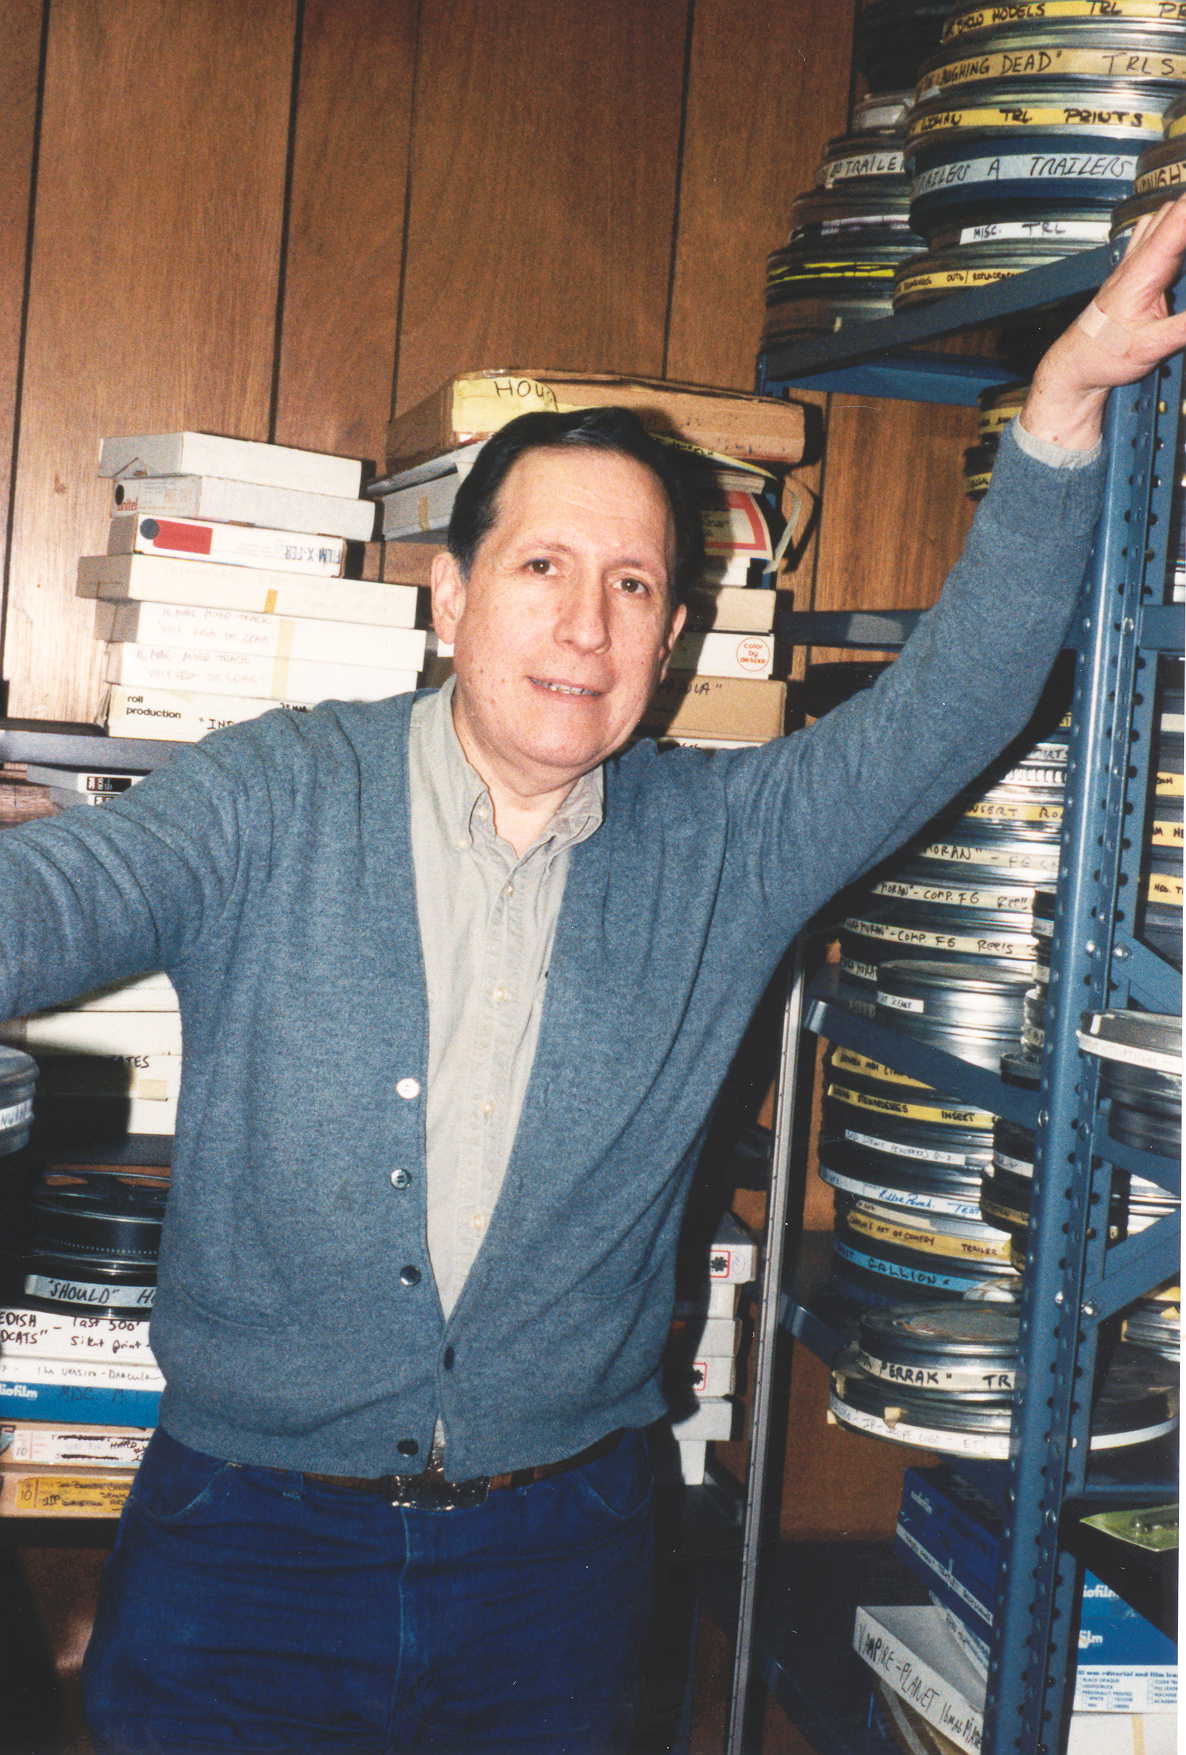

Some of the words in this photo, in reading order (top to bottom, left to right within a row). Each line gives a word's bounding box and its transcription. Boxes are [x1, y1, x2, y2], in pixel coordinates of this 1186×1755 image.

[1064, 108, 1143, 126] PRINTS
[1029, 156, 1133, 178] TRAILERS
[1022, 222, 1066, 237] TRL
[127, 695, 144, 704] roll
[126, 706, 181, 719] production
